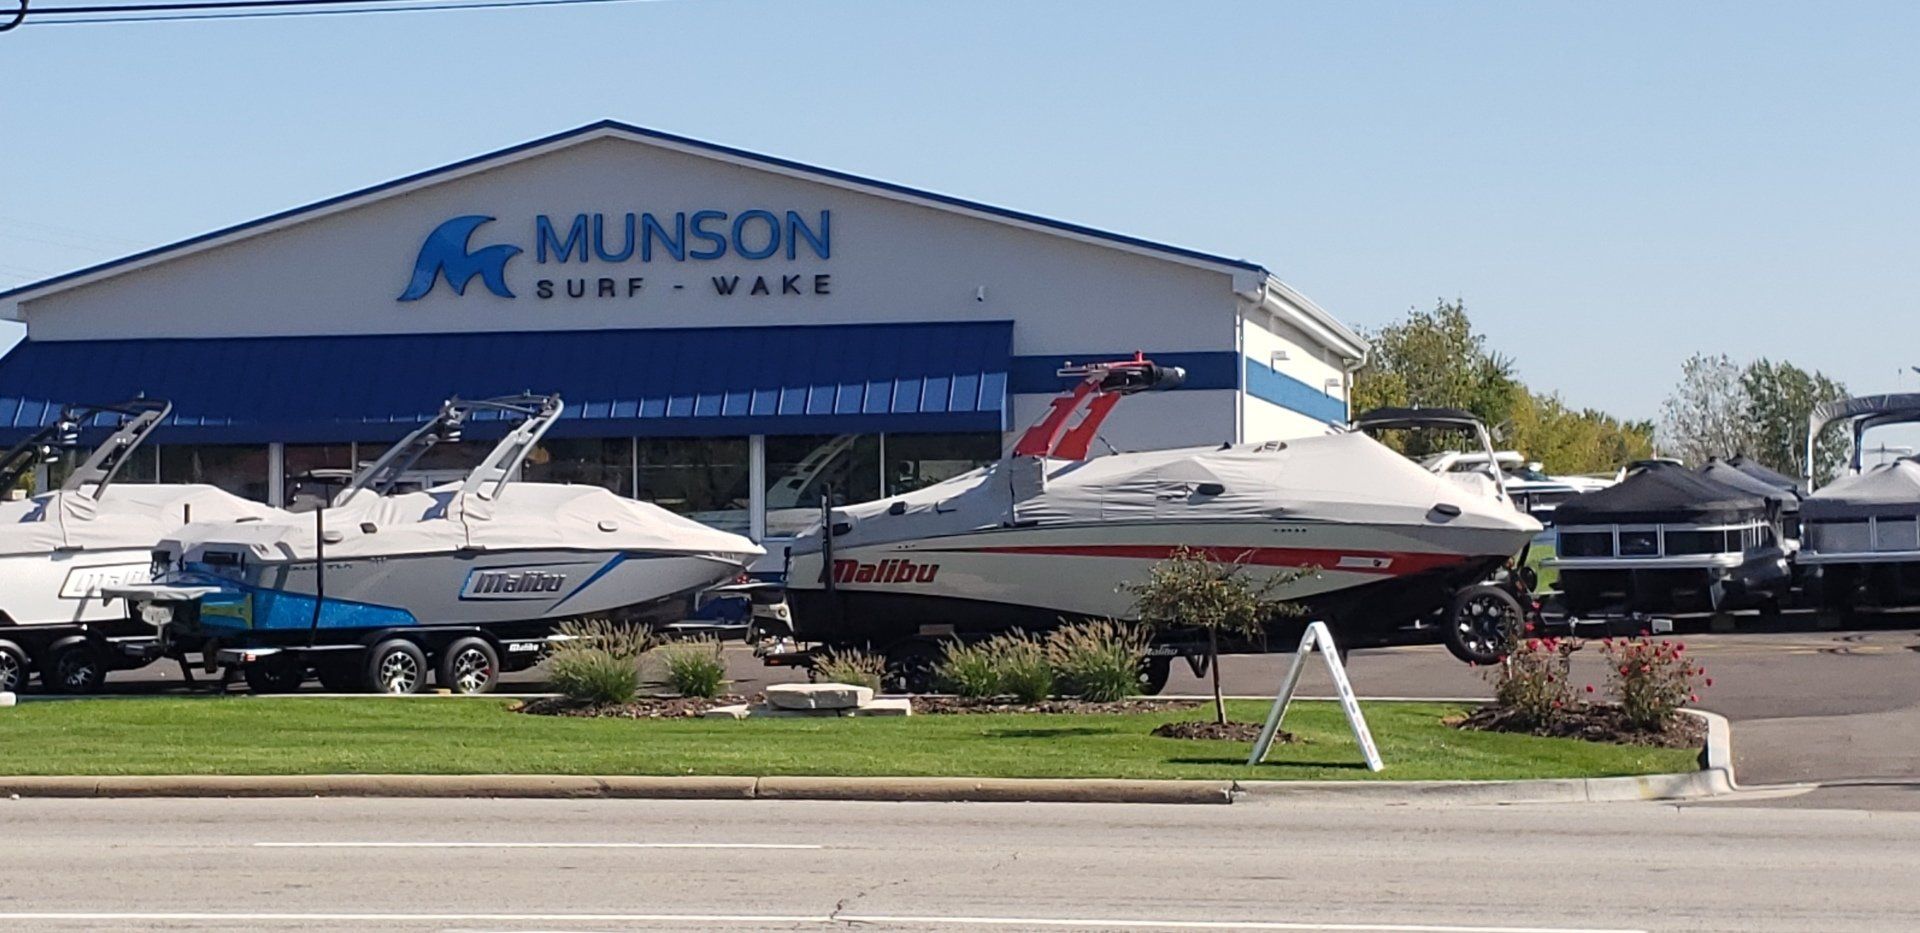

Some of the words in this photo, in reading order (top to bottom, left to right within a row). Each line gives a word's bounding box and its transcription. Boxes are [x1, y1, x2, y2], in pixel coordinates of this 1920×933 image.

[536, 209, 831, 264] MUNSON
[536, 277, 644, 299] SURF
[712, 274, 831, 296] WAKE
[473, 570, 567, 594] Malibu
[817, 558, 940, 584] Malibu
